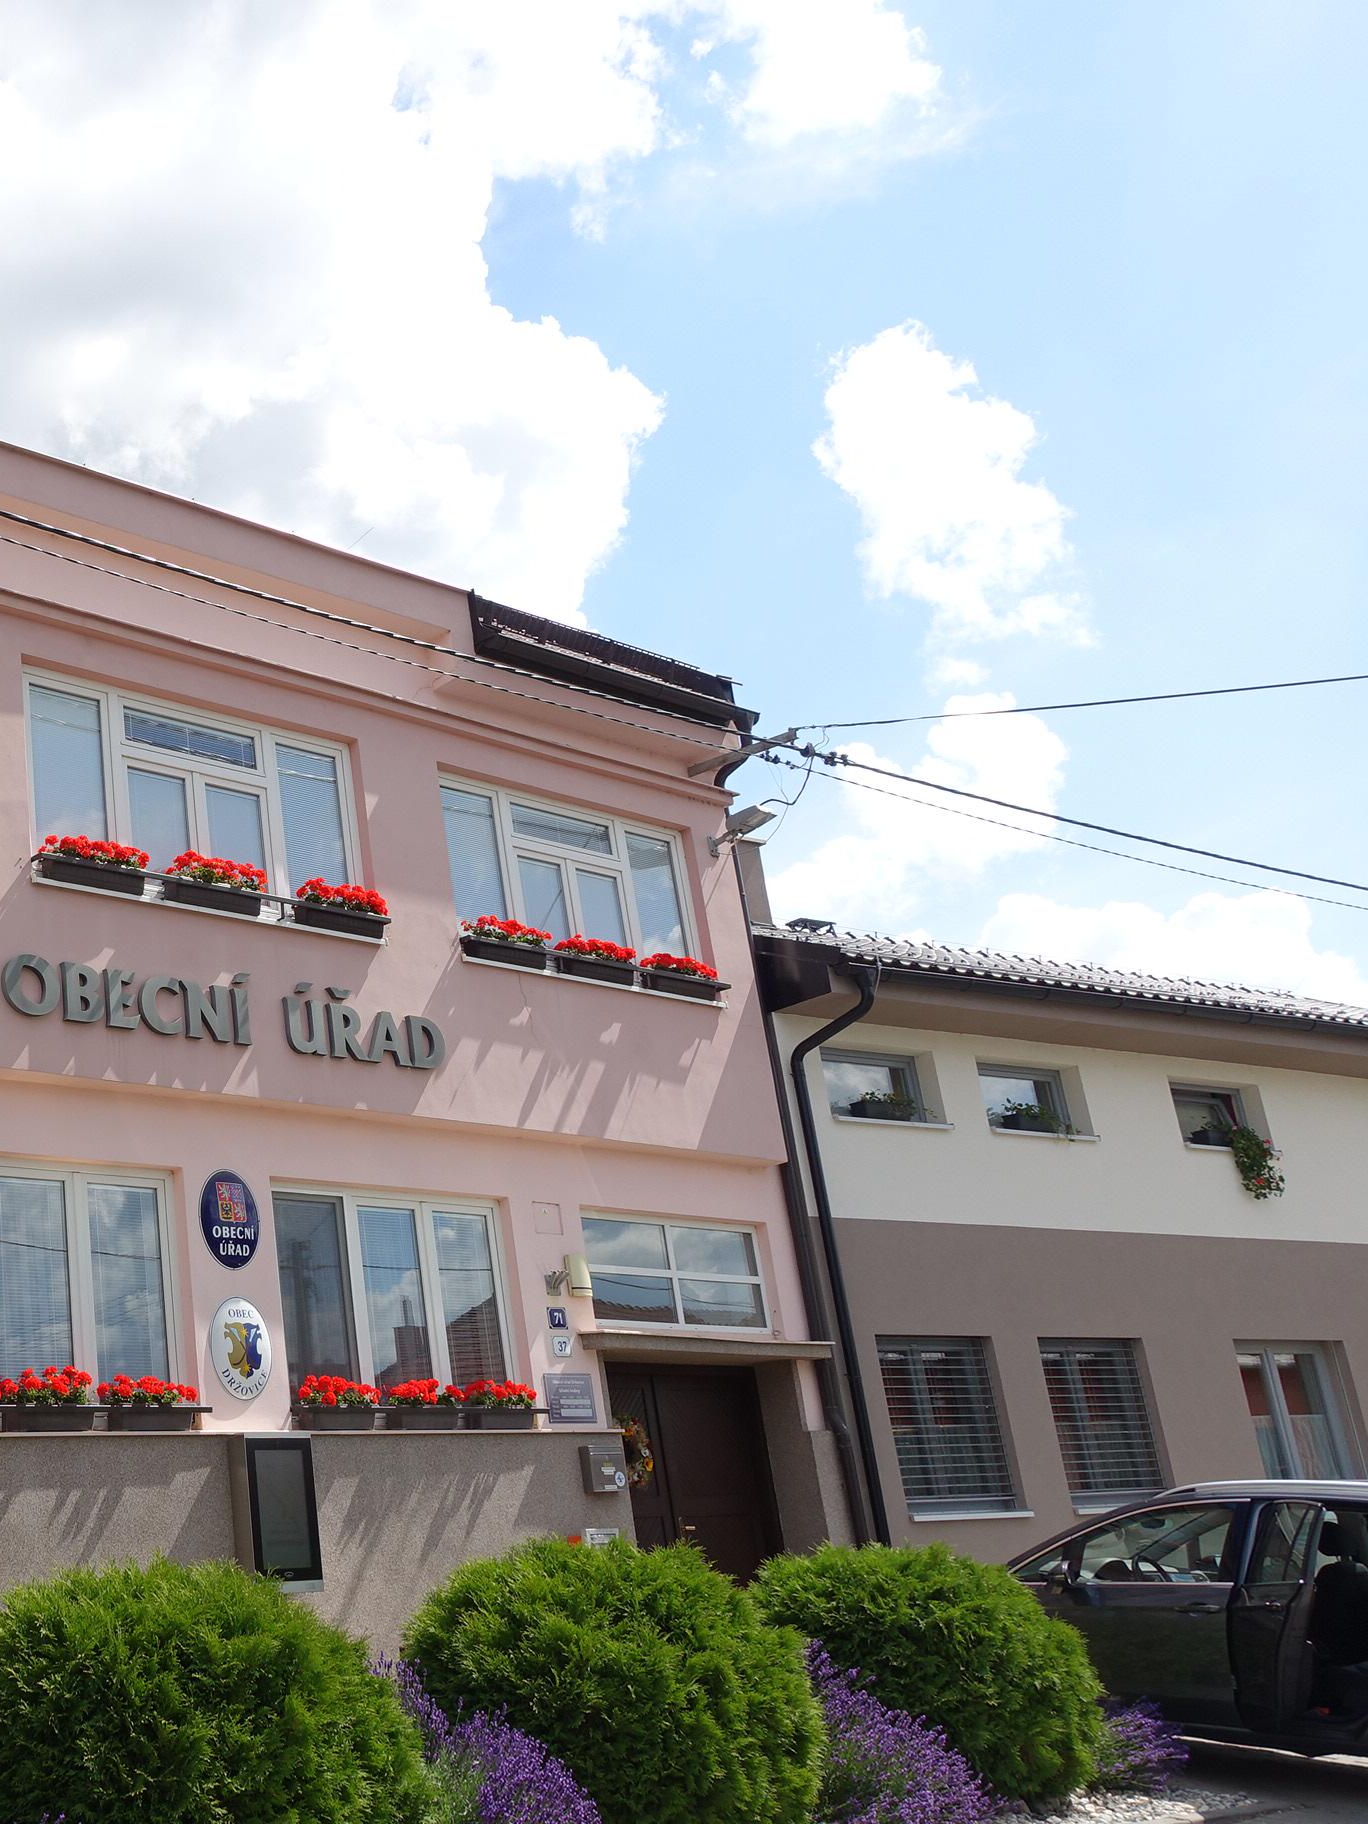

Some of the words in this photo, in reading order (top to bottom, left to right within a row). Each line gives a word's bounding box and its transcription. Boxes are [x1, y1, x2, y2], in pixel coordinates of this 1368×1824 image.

[1, 954, 252, 1046] OBECNÍ
[282, 981, 446, 1069] ÚŘAD
[212, 1225, 255, 1240] OBECNÍ
[219, 1240, 250, 1257] ÚŘAD
[228, 1308, 254, 1319] OBEC
[553, 1312, 563, 1325] 71
[557, 1341, 567, 1353] 37
[221, 1368, 268, 1397] DRŽOVICE
